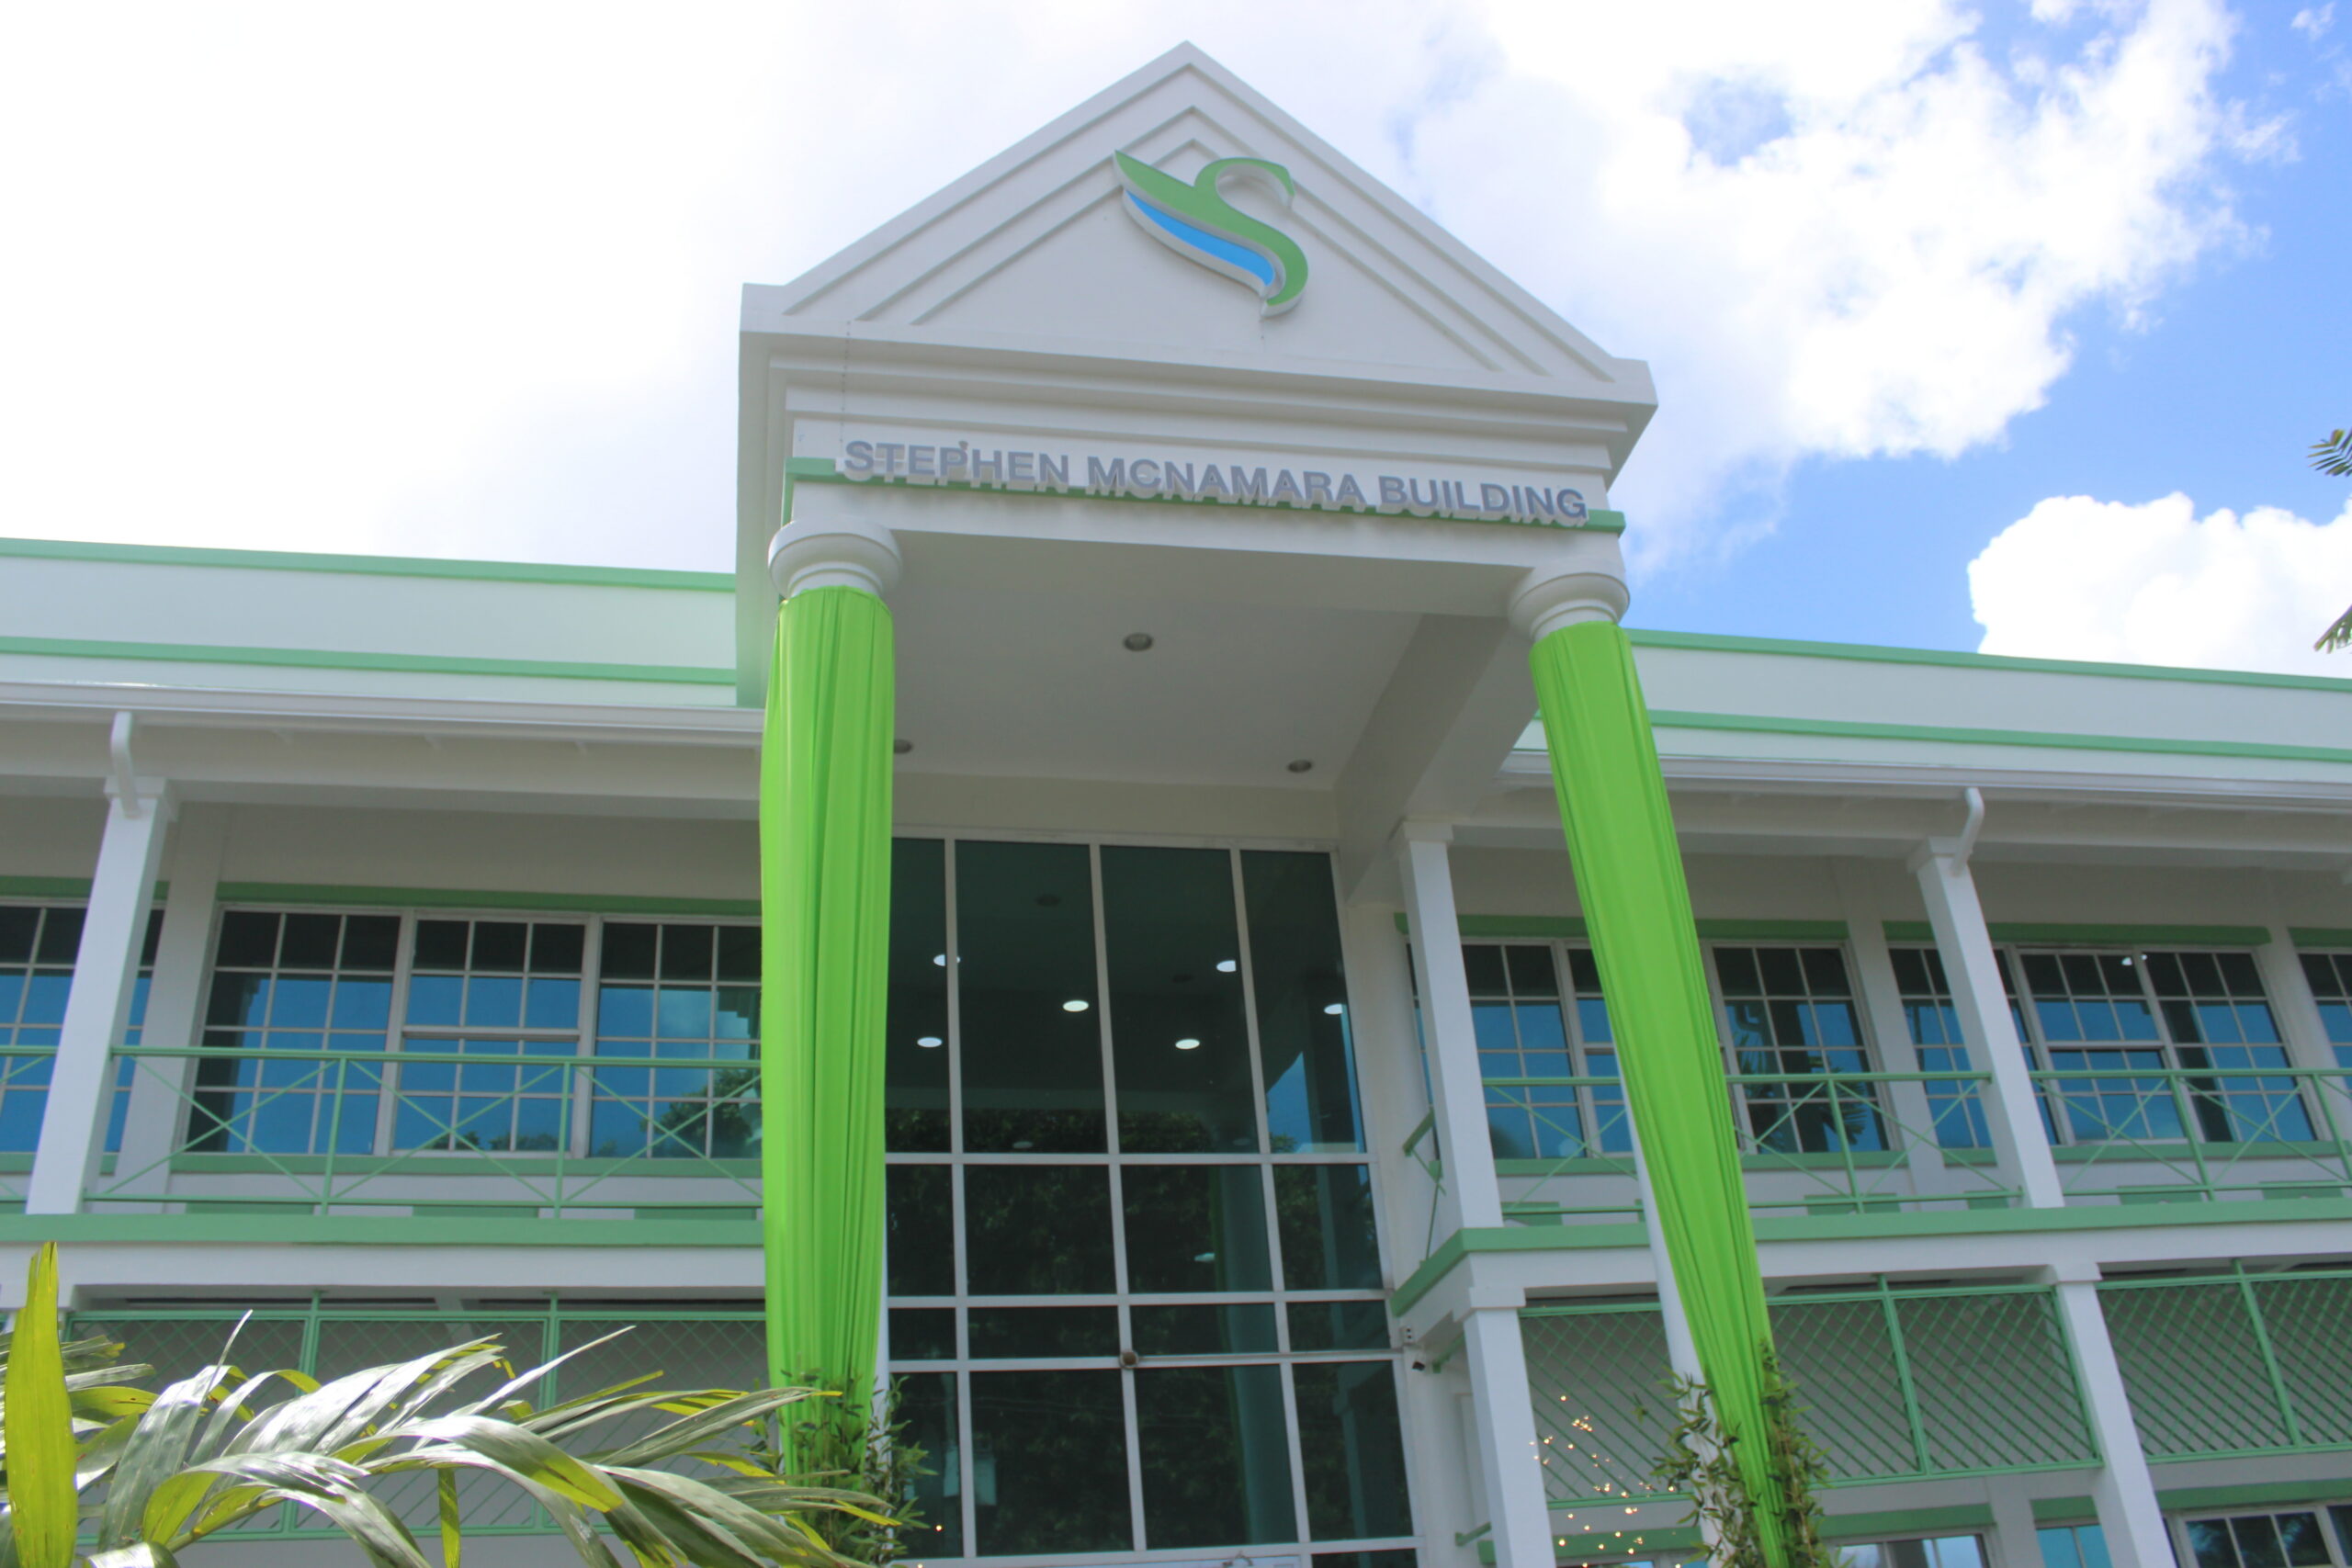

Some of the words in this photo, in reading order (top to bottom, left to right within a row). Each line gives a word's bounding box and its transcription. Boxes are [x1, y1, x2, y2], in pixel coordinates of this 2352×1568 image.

[843, 440, 1069, 485] STEPHEN
[1087, 456, 1368, 504] MCNAMARA
[1378, 475, 1589, 519] BUILDING
